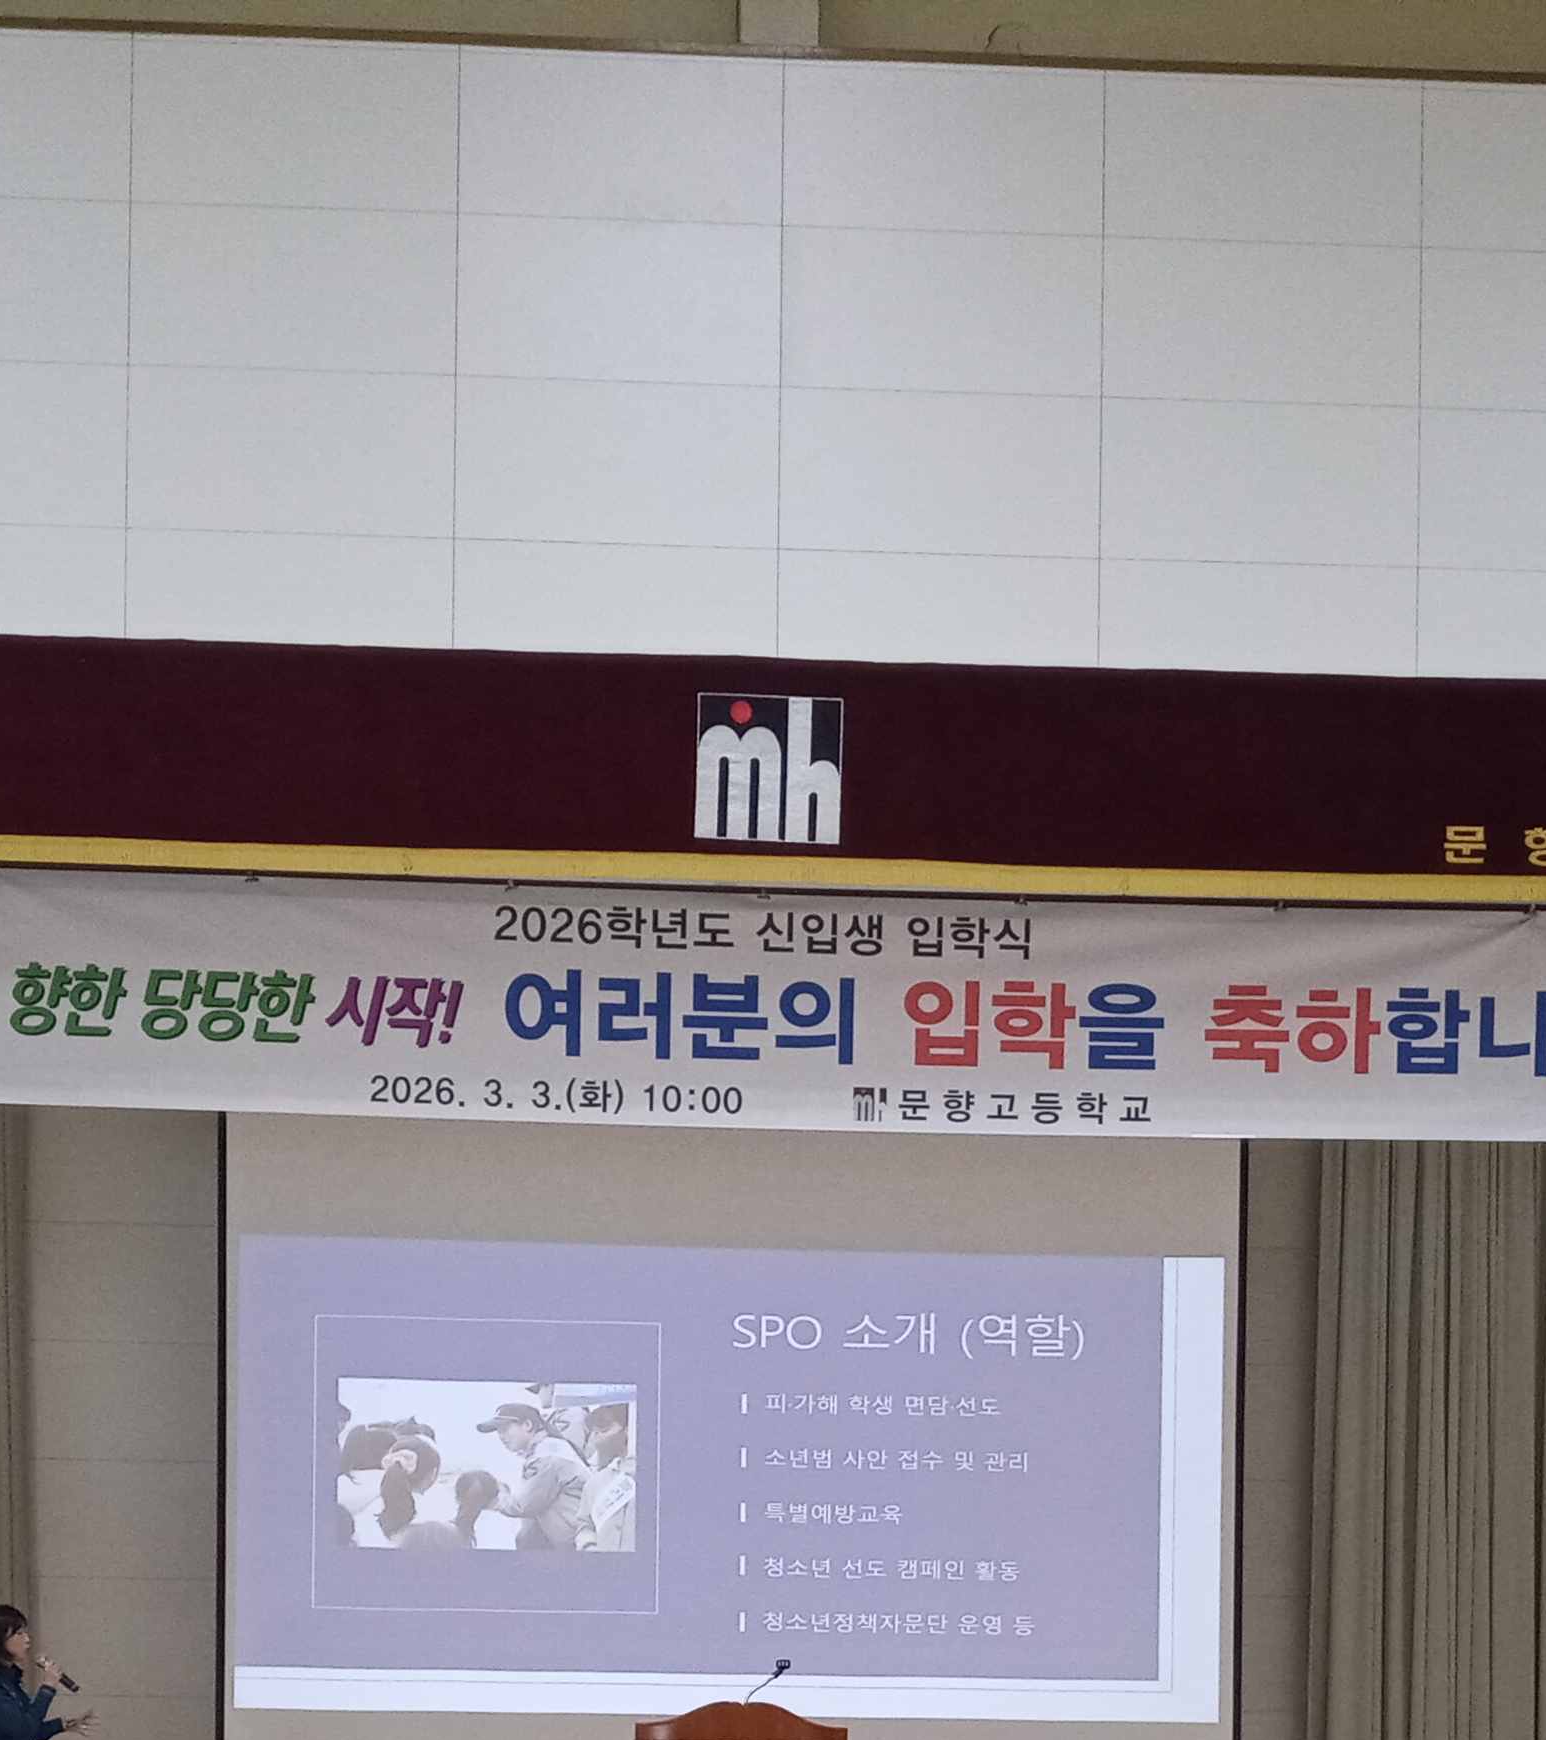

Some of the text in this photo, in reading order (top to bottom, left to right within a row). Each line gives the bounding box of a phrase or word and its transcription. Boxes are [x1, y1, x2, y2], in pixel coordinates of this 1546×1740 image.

[493, 906, 1032, 961] 2026학년도 신입생 입학식
[9, 961, 128, 1038] 향한
[141, 969, 317, 1044] 당당한
[325, 976, 465, 1049] 시작!
[505, 968, 855, 1065] 여러분의
[904, 980, 1165, 1070] 입학을
[370, 1074, 465, 1107] 2026.
[643, 1084, 743, 1114] 10:00
[898, 1089, 1151, 1125] 문향고등학교
[732, 1312, 1085, 1361] SPO 소개 (역할)
[848, 1394, 893, 1416] 학생
[764, 1448, 1028, 1473] 소년범 사안 접수 및 관리
[764, 1502, 903, 1525] 특별예방교육
[763, 1556, 1021, 1582] 청소년 선도 캠페인 활동
[762, 1611, 1035, 1636] 청소년정책자문단 운영 등
